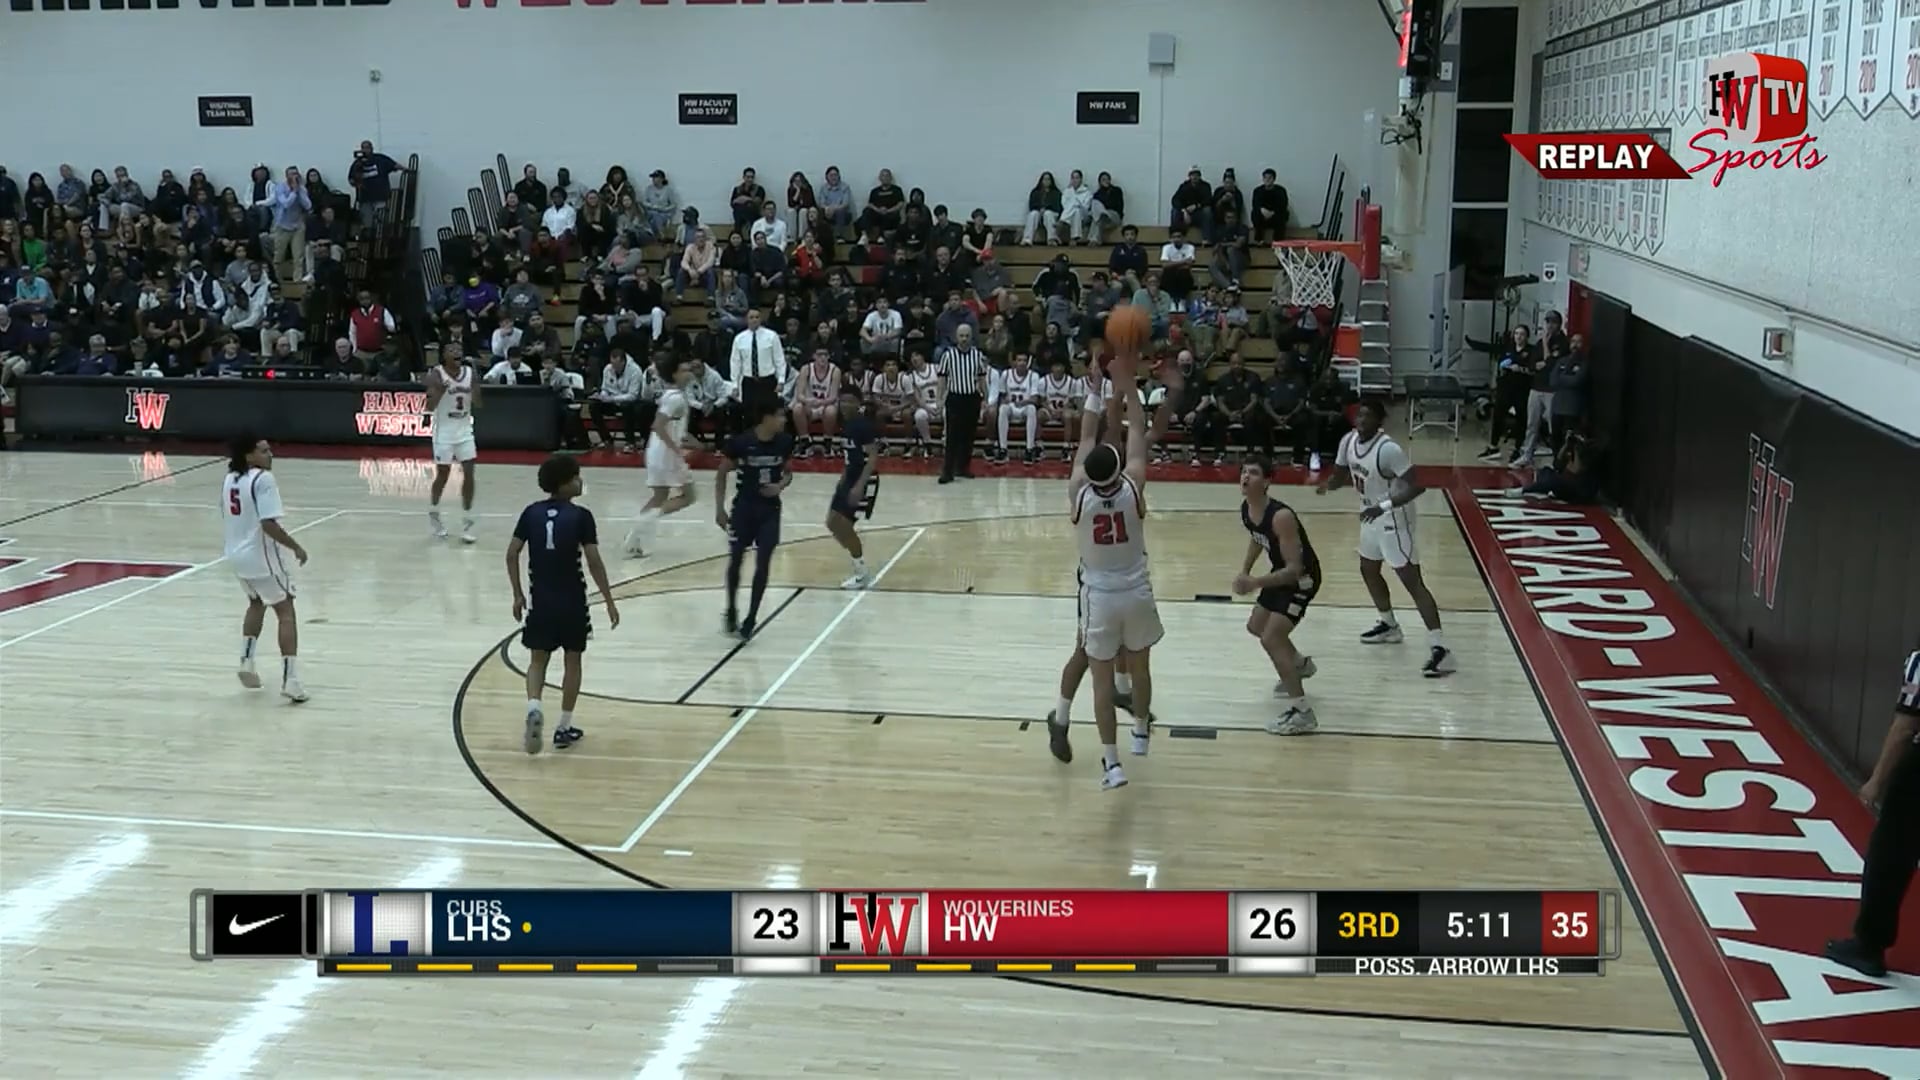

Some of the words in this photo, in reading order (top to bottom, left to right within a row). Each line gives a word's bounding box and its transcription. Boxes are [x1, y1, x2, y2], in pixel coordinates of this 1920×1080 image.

[684, 99, 698, 107] HW
[699, 99, 732, 107] FACULTY
[687, 107, 704, 115] AND
[705, 107, 729, 115] STAFF
[1089, 101, 1104, 109] HW
[1105, 101, 1127, 109] FANS
[125, 387, 170, 430] HW
[363, 391, 430, 413] HARV
[230, 487, 241, 516] 5
[545, 520, 556, 550] 1
[1092, 511, 1129, 545] 21
